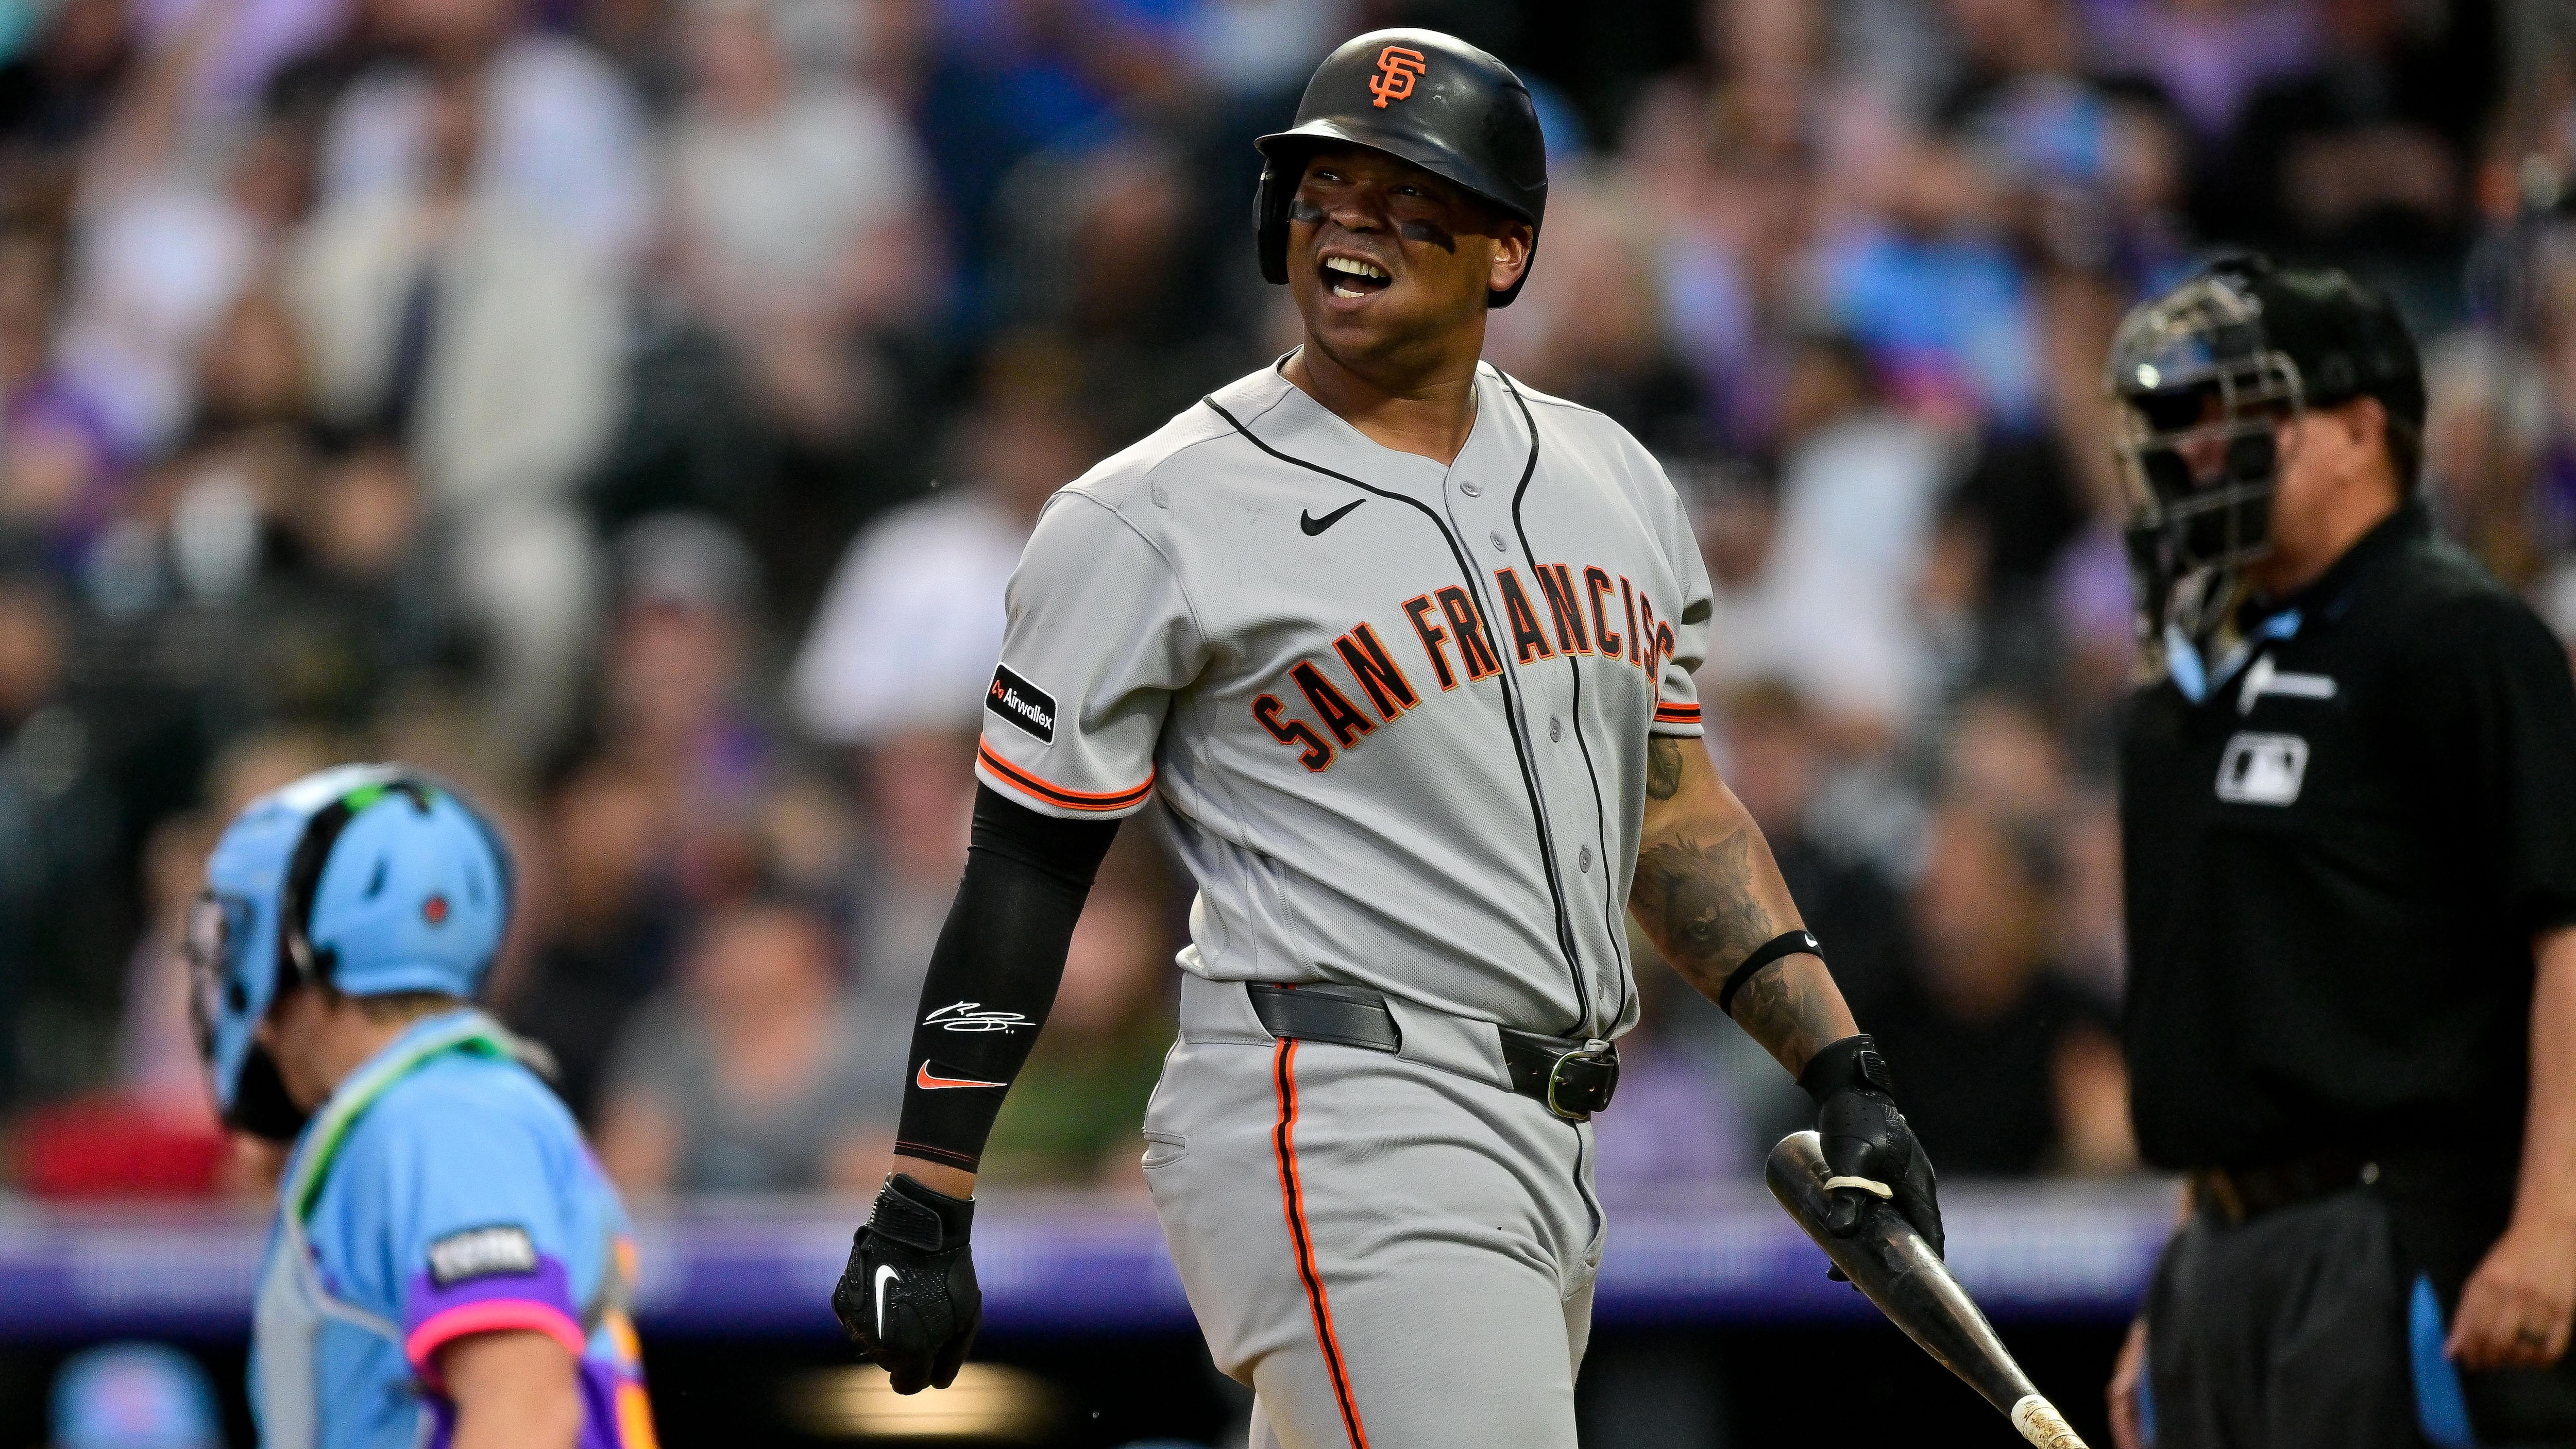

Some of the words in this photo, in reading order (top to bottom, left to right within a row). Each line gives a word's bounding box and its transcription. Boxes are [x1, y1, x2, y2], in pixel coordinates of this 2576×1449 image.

[1369, 45, 1426, 109] SF
[1003, 688, 1053, 730] Airwallex
[1251, 621, 1420, 772] SAN
